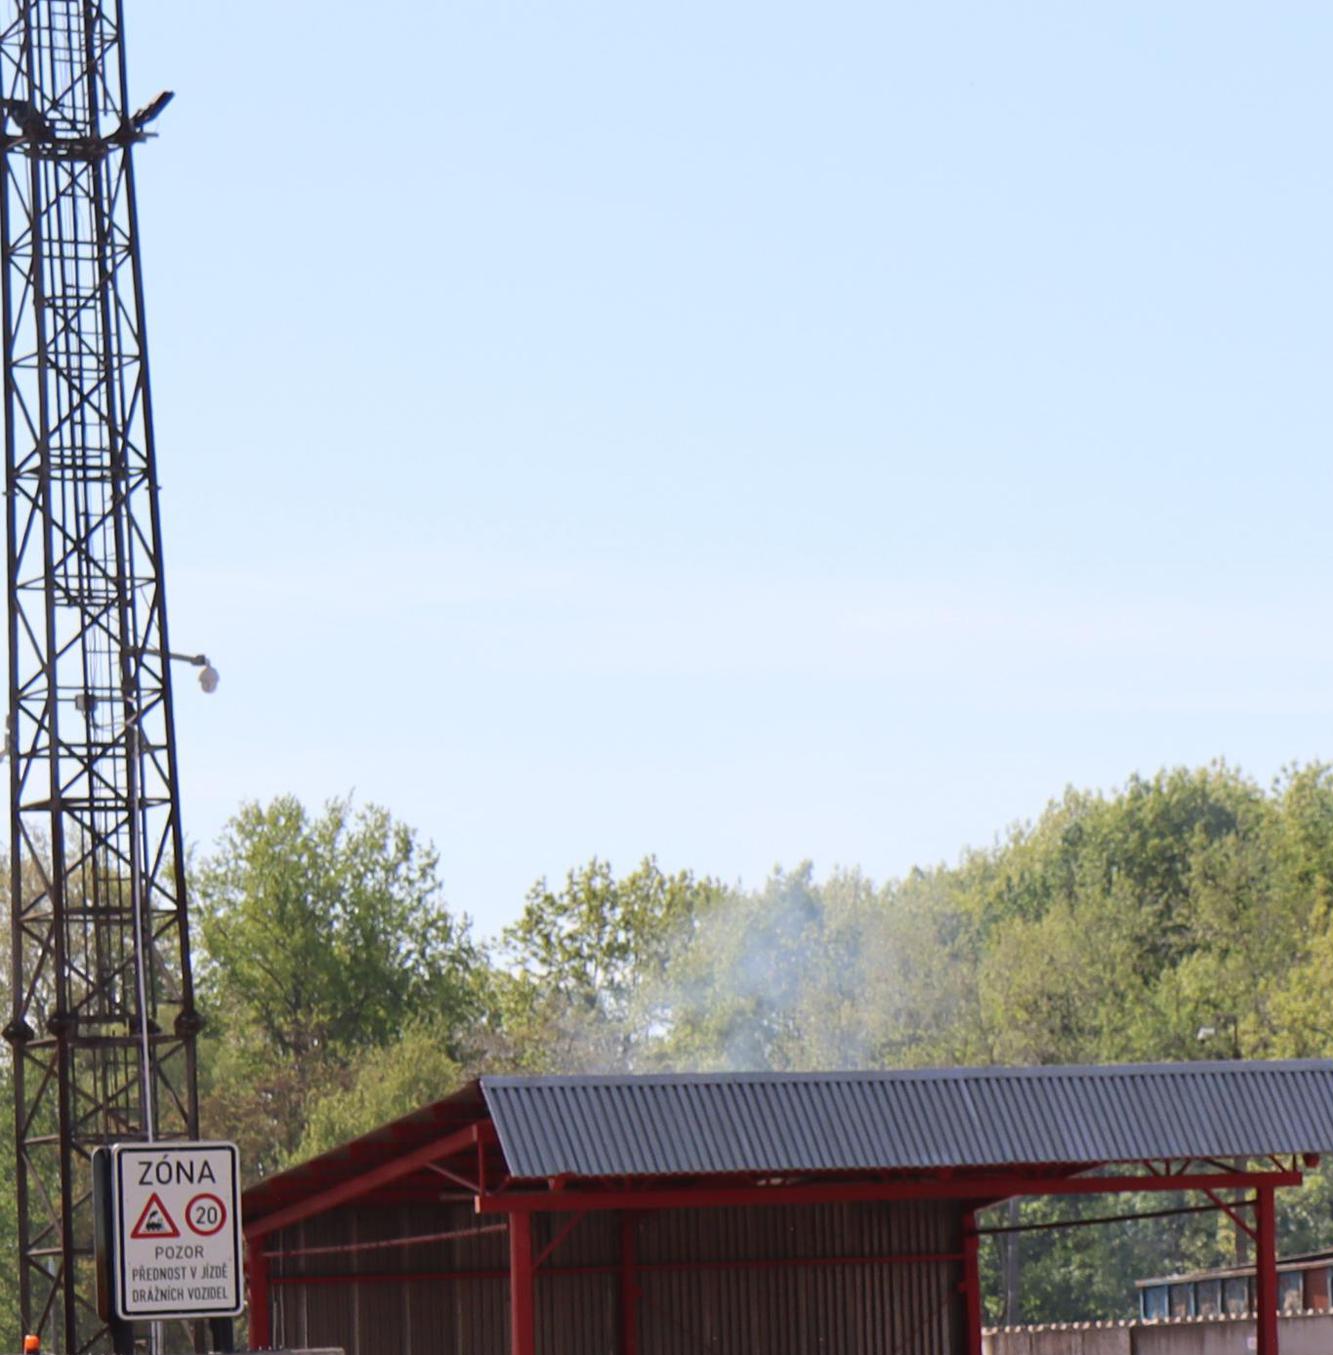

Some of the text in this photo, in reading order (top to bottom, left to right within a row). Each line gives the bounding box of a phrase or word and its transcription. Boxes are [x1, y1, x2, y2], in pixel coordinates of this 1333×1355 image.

[138, 1154, 216, 1186] ZÓNA
[195, 1206, 218, 1225] 20
[155, 1245, 204, 1260] POZOR
[132, 1262, 228, 1281] PŘEDNOST V JÍZDĚ
[132, 1284, 228, 1303] DRÁŽNÍCH VOZIDEL
